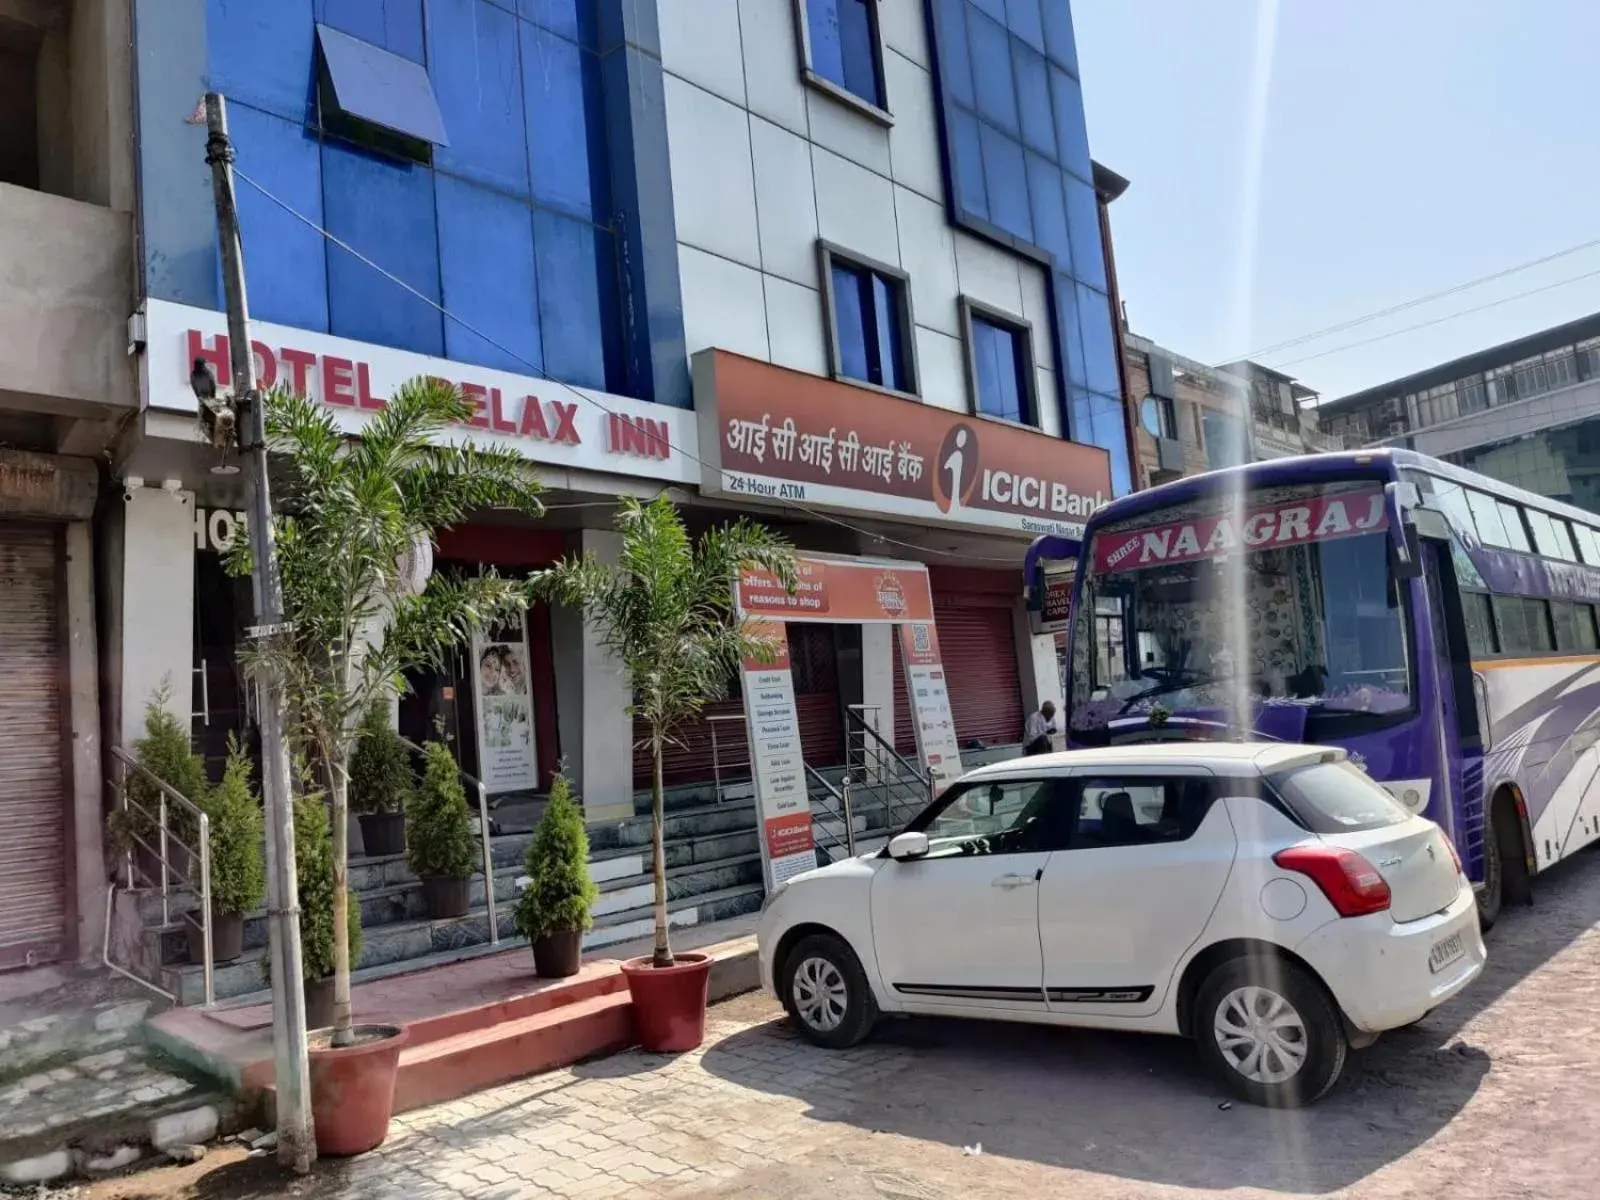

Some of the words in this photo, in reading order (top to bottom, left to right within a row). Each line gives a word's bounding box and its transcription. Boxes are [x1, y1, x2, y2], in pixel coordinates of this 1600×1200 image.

[187, 329, 387, 410] HOTEL
[609, 412, 671, 460] INN
[727, 413, 770, 464] आई
[772, 417, 797, 462] सी
[799, 428, 836, 475] आई
[839, 431, 861, 472] सी
[862, 440, 895, 484] आई
[897, 441, 924, 483] बैंक
[729, 475, 745, 492] 24
[747, 479, 777, 496] Hour
[779, 484, 806, 500] ATM
[982, 468, 1047, 510] ICICI
[1106, 534, 1141, 568] SHREE
[1139, 494, 1387, 564] NAAGRAJ
[800, 595, 821, 609] shop
